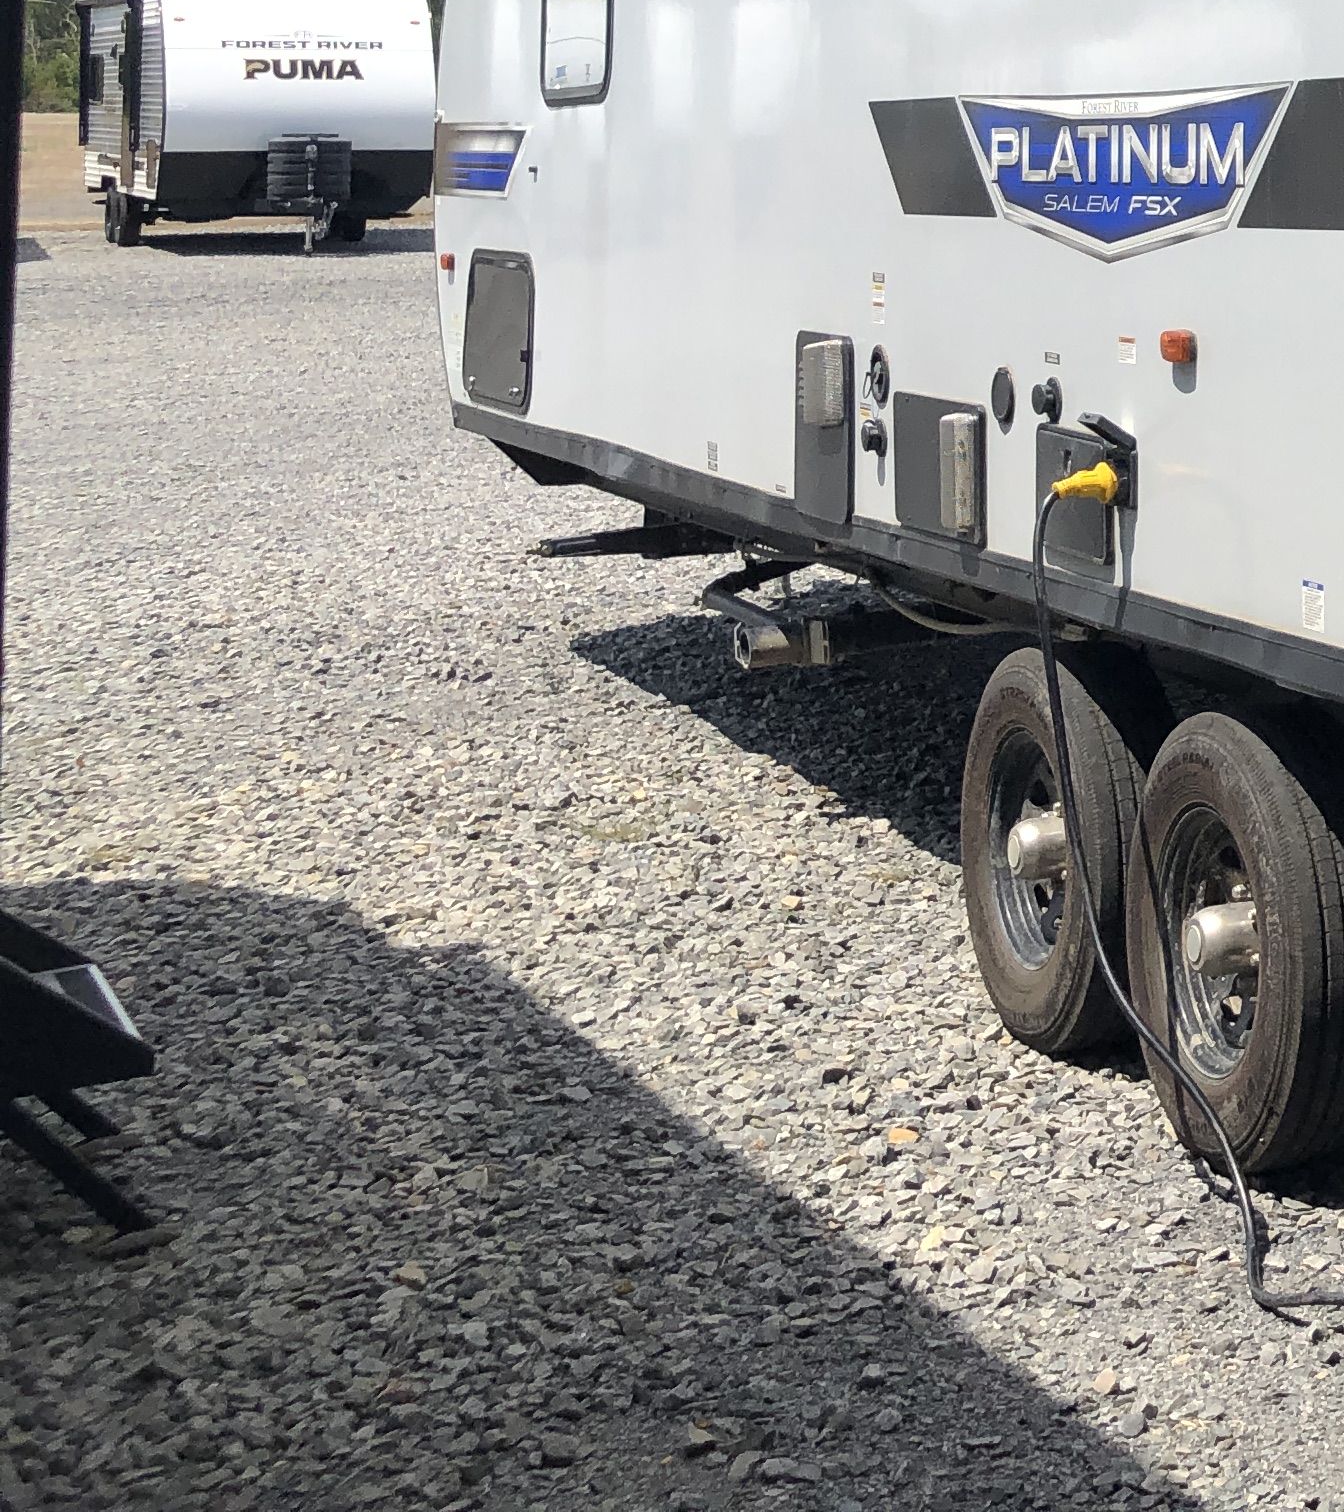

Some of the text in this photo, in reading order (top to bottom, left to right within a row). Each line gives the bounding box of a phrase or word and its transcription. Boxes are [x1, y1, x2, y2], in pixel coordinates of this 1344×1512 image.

[221, 40, 383, 50] FOREST RIVER
[243, 58, 365, 80] PUMA
[1081, 99, 1139, 115] FOREST RIVER
[991, 122, 1246, 188] PLATINUM
[1043, 194, 1182, 216] SALEM FSX
